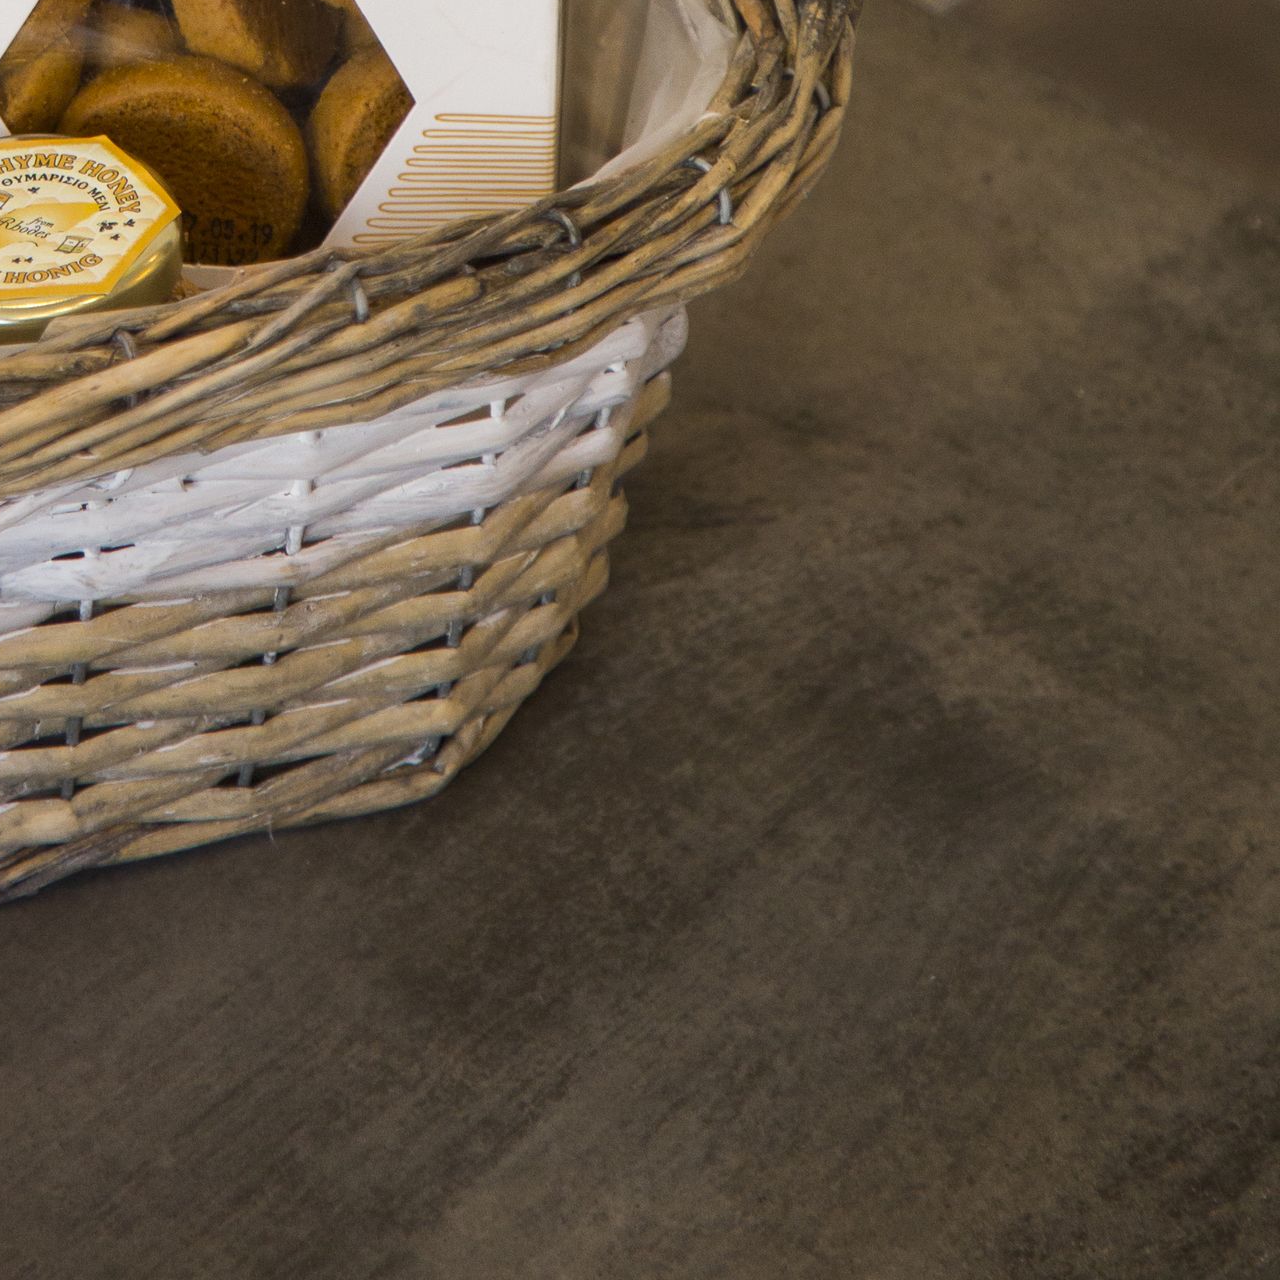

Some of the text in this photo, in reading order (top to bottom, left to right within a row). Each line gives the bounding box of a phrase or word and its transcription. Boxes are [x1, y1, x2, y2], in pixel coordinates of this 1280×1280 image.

[1, 172, 111, 212] ΘΥΜΑΡΙΣΙΟ ΜΕΛΙ
[80, 158, 141, 214] HONEY
[28, 215, 55, 230] from
[3, 252, 104, 284] HONIG
